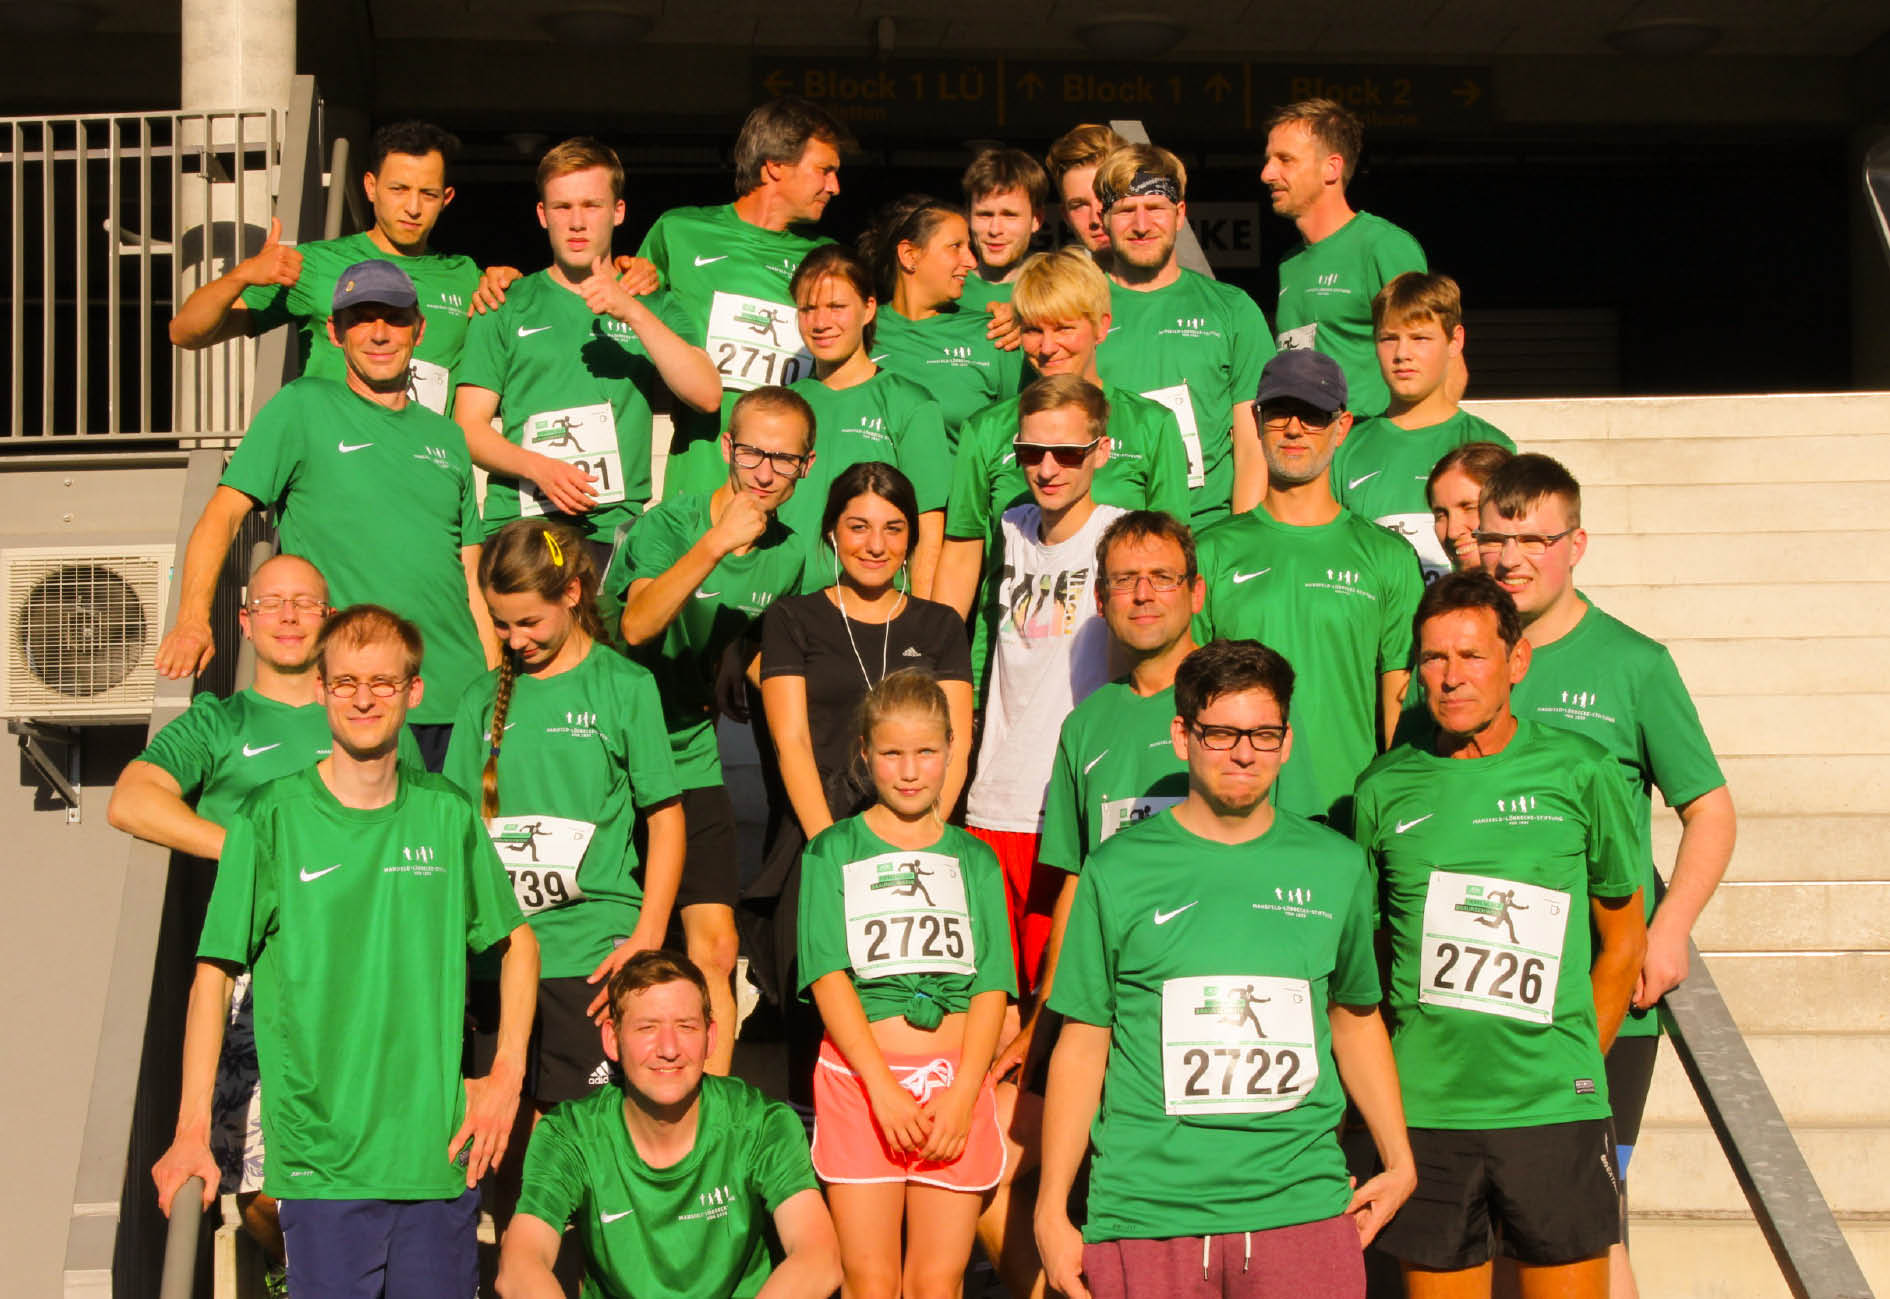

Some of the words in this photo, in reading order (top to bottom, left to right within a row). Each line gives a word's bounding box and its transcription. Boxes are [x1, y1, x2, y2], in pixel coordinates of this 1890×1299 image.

[803, 70, 897, 101] Block
[911, 71, 927, 102] 1
[937, 66, 985, 102] LÜ
[1063, 73, 1154, 104] Block
[1168, 73, 1183, 104] 1
[1290, 76, 1384, 105] Block
[1392, 79, 1414, 105] 2
[716, 342, 801, 387] 2710
[864, 915, 964, 963] 2725
[1433, 942, 1545, 1004] 2726
[1183, 1048, 1301, 1096] 2722
